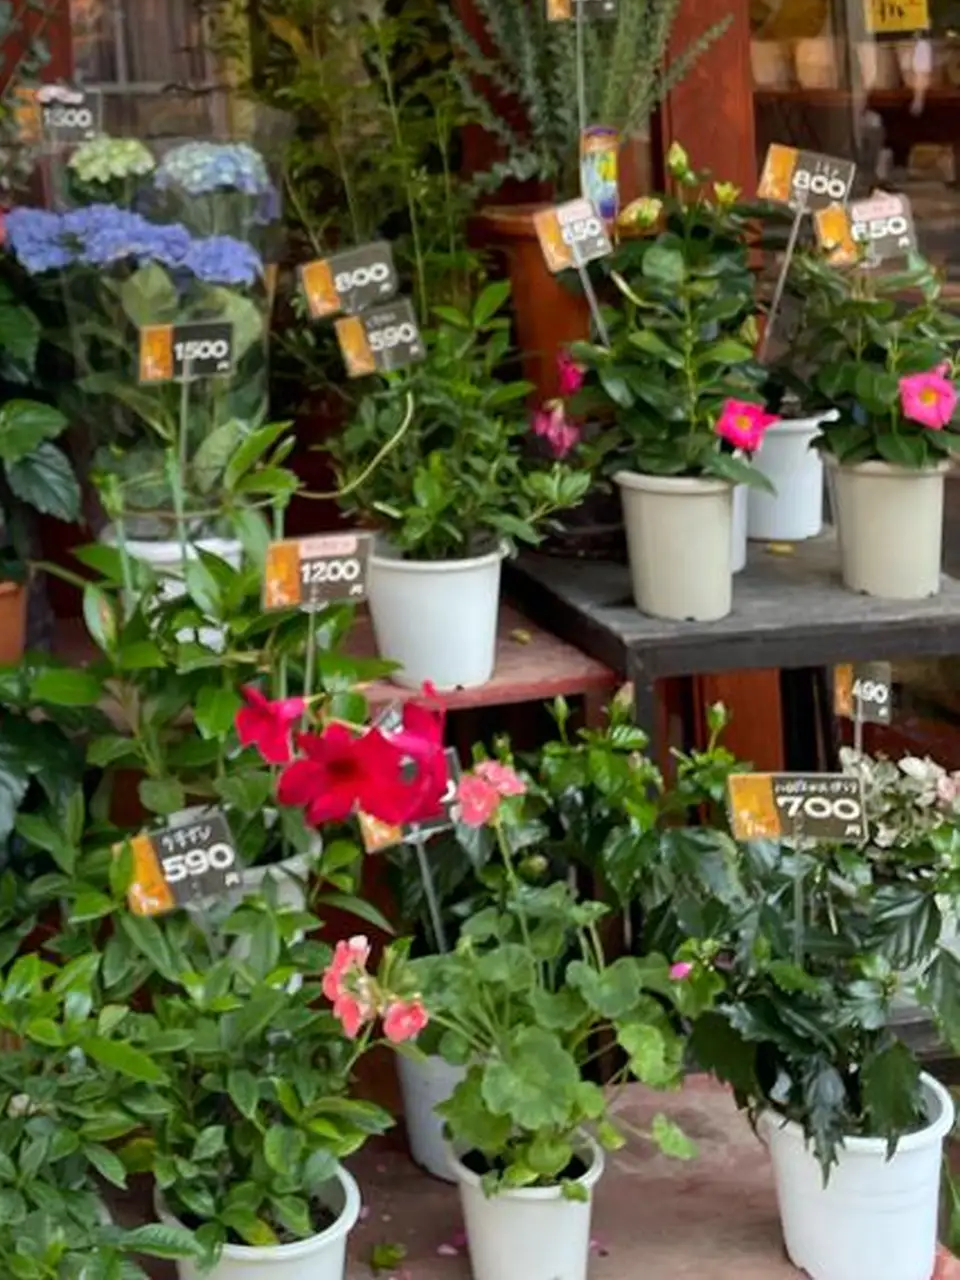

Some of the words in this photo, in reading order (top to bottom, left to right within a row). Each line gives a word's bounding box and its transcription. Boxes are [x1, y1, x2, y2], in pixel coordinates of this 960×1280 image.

[792, 169, 846, 199] 800
[334, 262, 389, 293] 800
[174, 339, 228, 361] 1500
[369, 322, 416, 352] 590
[301, 558, 360, 585] 1200
[776, 796, 861, 821] 700
[161, 842, 235, 884] 590
